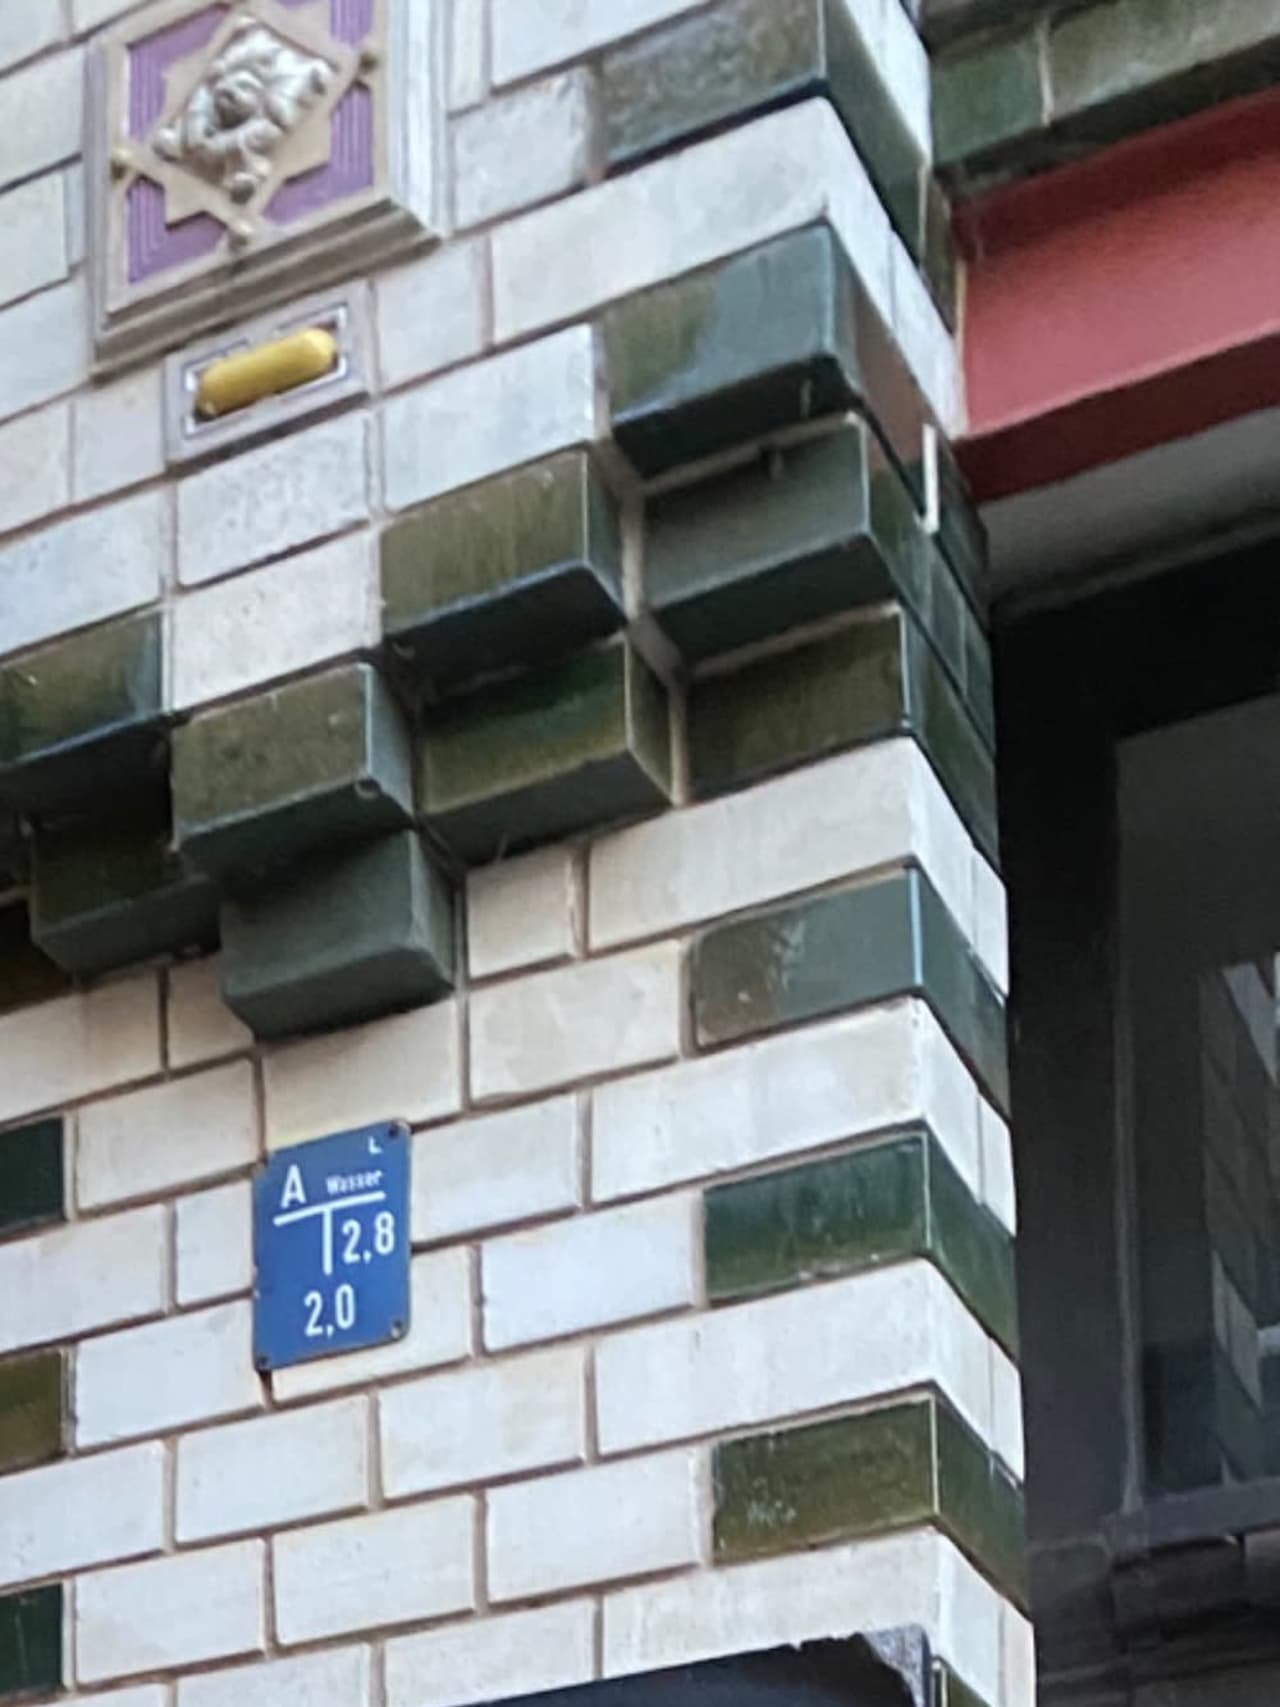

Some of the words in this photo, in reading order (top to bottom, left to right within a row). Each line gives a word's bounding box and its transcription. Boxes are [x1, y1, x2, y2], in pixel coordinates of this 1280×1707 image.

[281, 1164, 307, 1209] A
[325, 1170, 383, 1195] Wasser
[304, 1283, 355, 1338] 2,0
